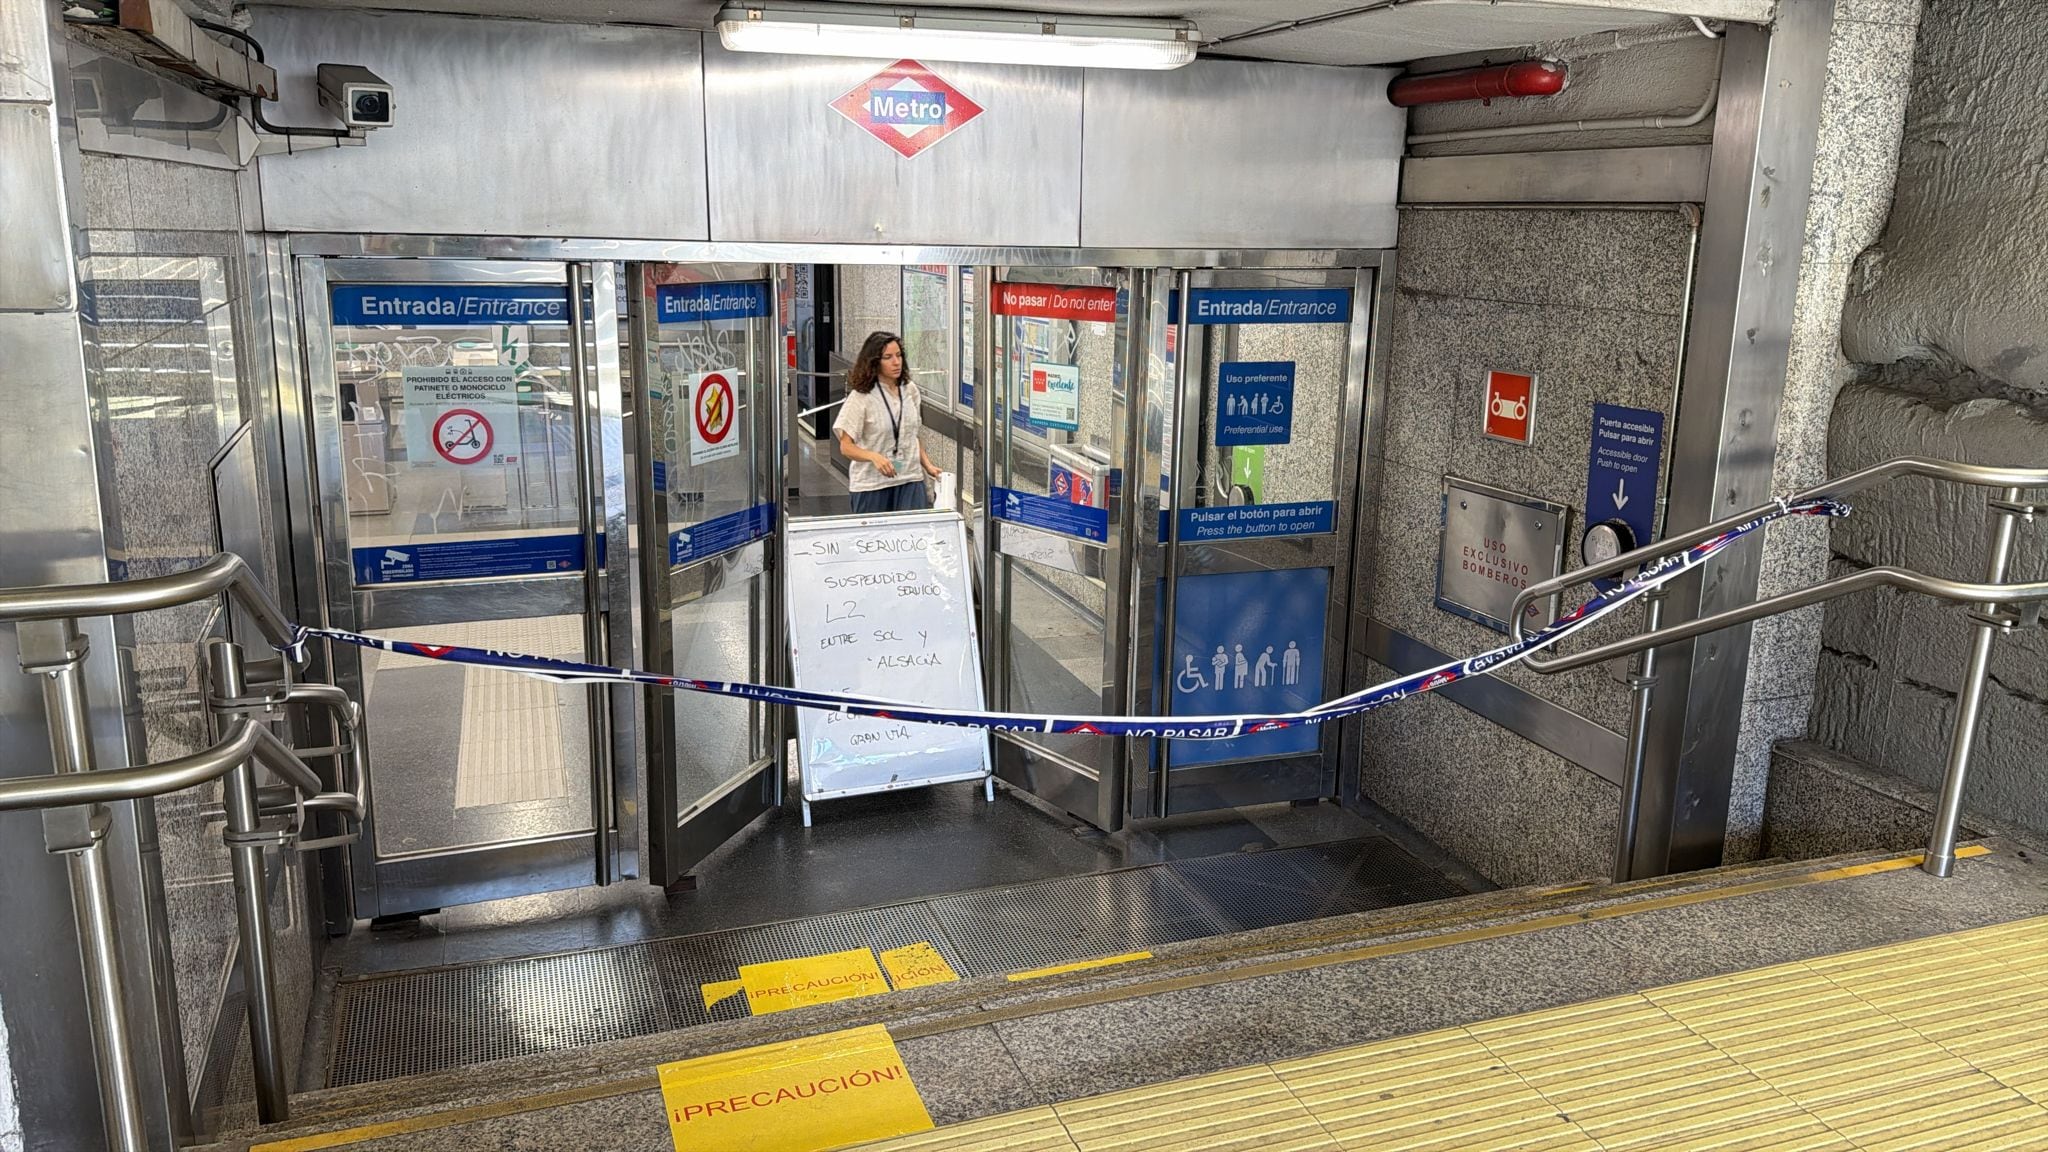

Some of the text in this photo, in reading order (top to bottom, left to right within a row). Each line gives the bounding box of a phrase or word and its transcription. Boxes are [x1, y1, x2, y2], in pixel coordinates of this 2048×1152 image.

[874, 96, 942, 119] Metro
[1003, 292, 1016, 305] No
[1019, 296, 1048, 310] pasar
[1053, 294, 1068, 308] Do
[1069, 297, 1086, 309] not
[1088, 298, 1115, 312] enter
[1226, 374, 1288, 385] Uso preferente
[435, 392, 486, 400] ELÉCTRICOS
[1224, 425, 1283, 435] Preferential use
[1600, 417, 1655, 434] Puerta accesible
[1599, 428, 1654, 446] Pulsar para abrir
[1598, 446, 1649, 463] Accessible door
[1597, 457, 1638, 473] Push to open
[1191, 505, 1323, 522] Pulsar el botón para abrir
[1196, 521, 1315, 536] Press the button to open
[812, 541, 840, 555] SIN
[1483, 537, 1506, 553] USO
[1463, 545, 1529, 576] EXCLUSIVO
[1462, 560, 1527, 590] BOMBEROS
[826, 600, 866, 624] L2
[820, 633, 858, 649] ENTRE
[873, 630, 903, 641] SOL
[749, 971, 879, 1000] ¡PRECAUCIÓN!
[674, 1065, 903, 1123] ¡PRECAUCIÓN!
